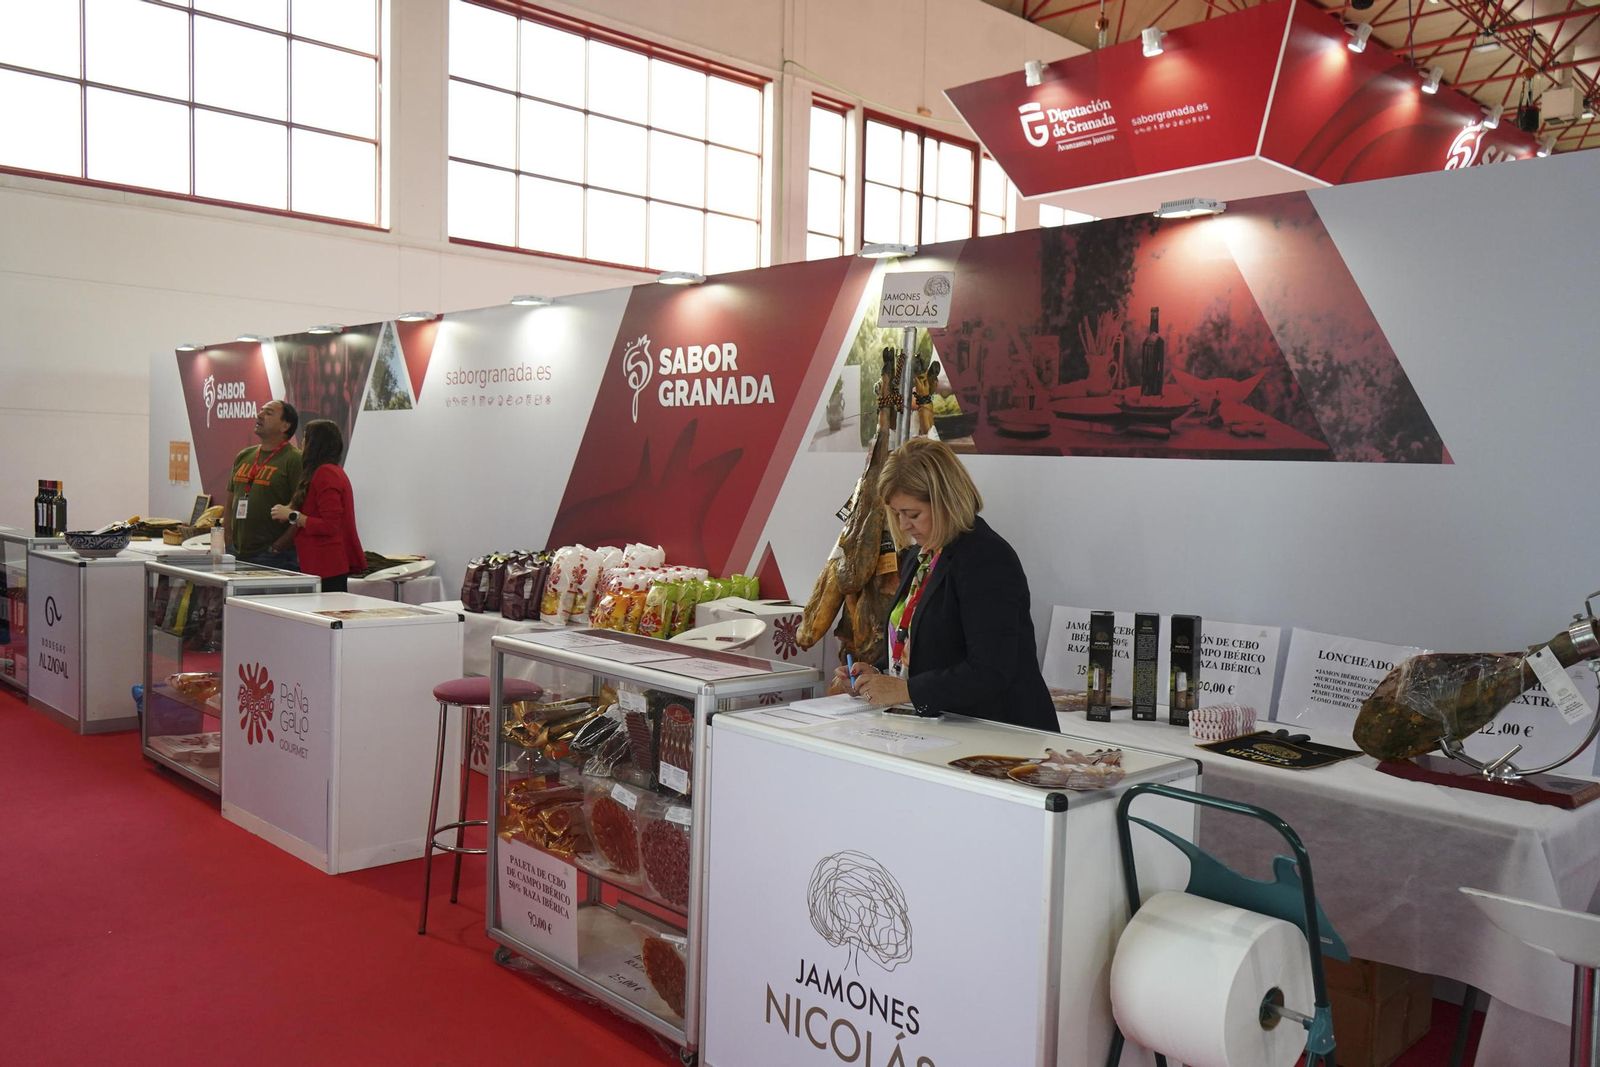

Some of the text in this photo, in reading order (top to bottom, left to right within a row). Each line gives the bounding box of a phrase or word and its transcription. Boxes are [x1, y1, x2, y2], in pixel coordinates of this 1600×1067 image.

[1047, 100, 1112, 122] Diputación
[1132, 102, 1209, 127] saborgranada.es
[1053, 114, 1116, 137] de Granada
[884, 293, 920, 301] JAMONES
[882, 301, 938, 316] NICOLÁS
[658, 342, 738, 375] SABOR
[446, 361, 552, 389] saborgranada.es
[217, 381, 246, 400] SABOR
[658, 374, 775, 407] GRANADA
[217, 401, 258, 419] GRANADA
[1066, 621, 1091, 631] JAMÓ
[42, 637, 66, 655] BODEGAS
[1200, 633, 1260, 650] ÓN DE CEBO
[1112, 649, 1130, 659] ICA
[1200, 648, 1266, 664] MPO IBÉRICO
[1318, 650, 1395, 671] LONCHEADO
[1200, 660, 1261, 675] AZA IBÉRICA
[1227, 684, 1236, 696] €
[1523, 725, 1535, 738] €
[280, 739, 309, 760] GOURMET
[509, 855, 567, 890] PALETA DE CEBO
[506, 866, 571, 906] DE CAMPO IBÉRICO
[508, 880, 570, 919] 50% RAZA IBÉRICA
[547, 923, 553, 935] €
[795, 958, 919, 1035] JAMONES
[765, 982, 936, 1067] NICOLÁ
